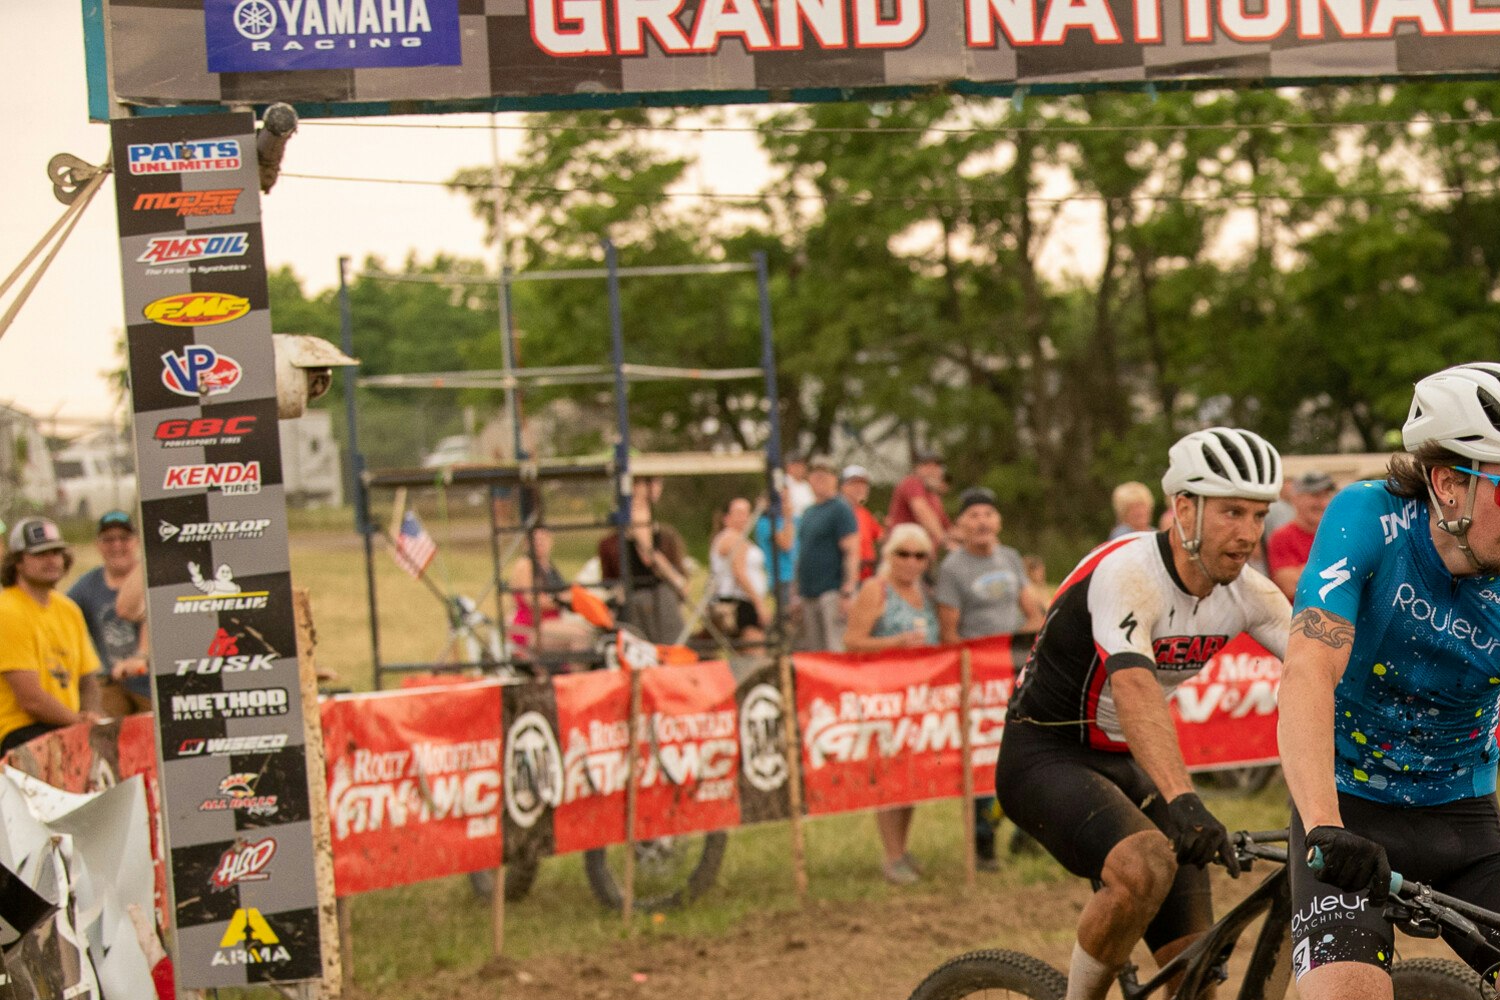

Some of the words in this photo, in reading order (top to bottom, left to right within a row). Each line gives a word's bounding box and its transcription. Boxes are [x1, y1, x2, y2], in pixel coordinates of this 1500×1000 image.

[278, 0, 432, 36] YAMAHA
[251, 37, 423, 51] RACING
[130, 141, 239, 162] PARTS
[131, 158, 240, 174] UNLIMITED
[133, 188, 244, 210] MOOSE
[143, 235, 248, 263] AMSOIL
[145, 297, 250, 320] FMF
[165, 348, 216, 393] VP
[155, 415, 258, 441] GBC
[165, 463, 260, 487] KENDA
[223, 484, 260, 494] TIRES
[180, 518, 272, 536] DUNLOP
[173, 596, 269, 614] MICHELIN
[174, 653, 277, 677] TUSK
[171, 688, 288, 712] METHOD
[173, 711, 214, 721] RACE
[221, 706, 288, 718] WHEELS
[206, 733, 289, 753] WISECO
[210, 945, 293, 967] ARMA
